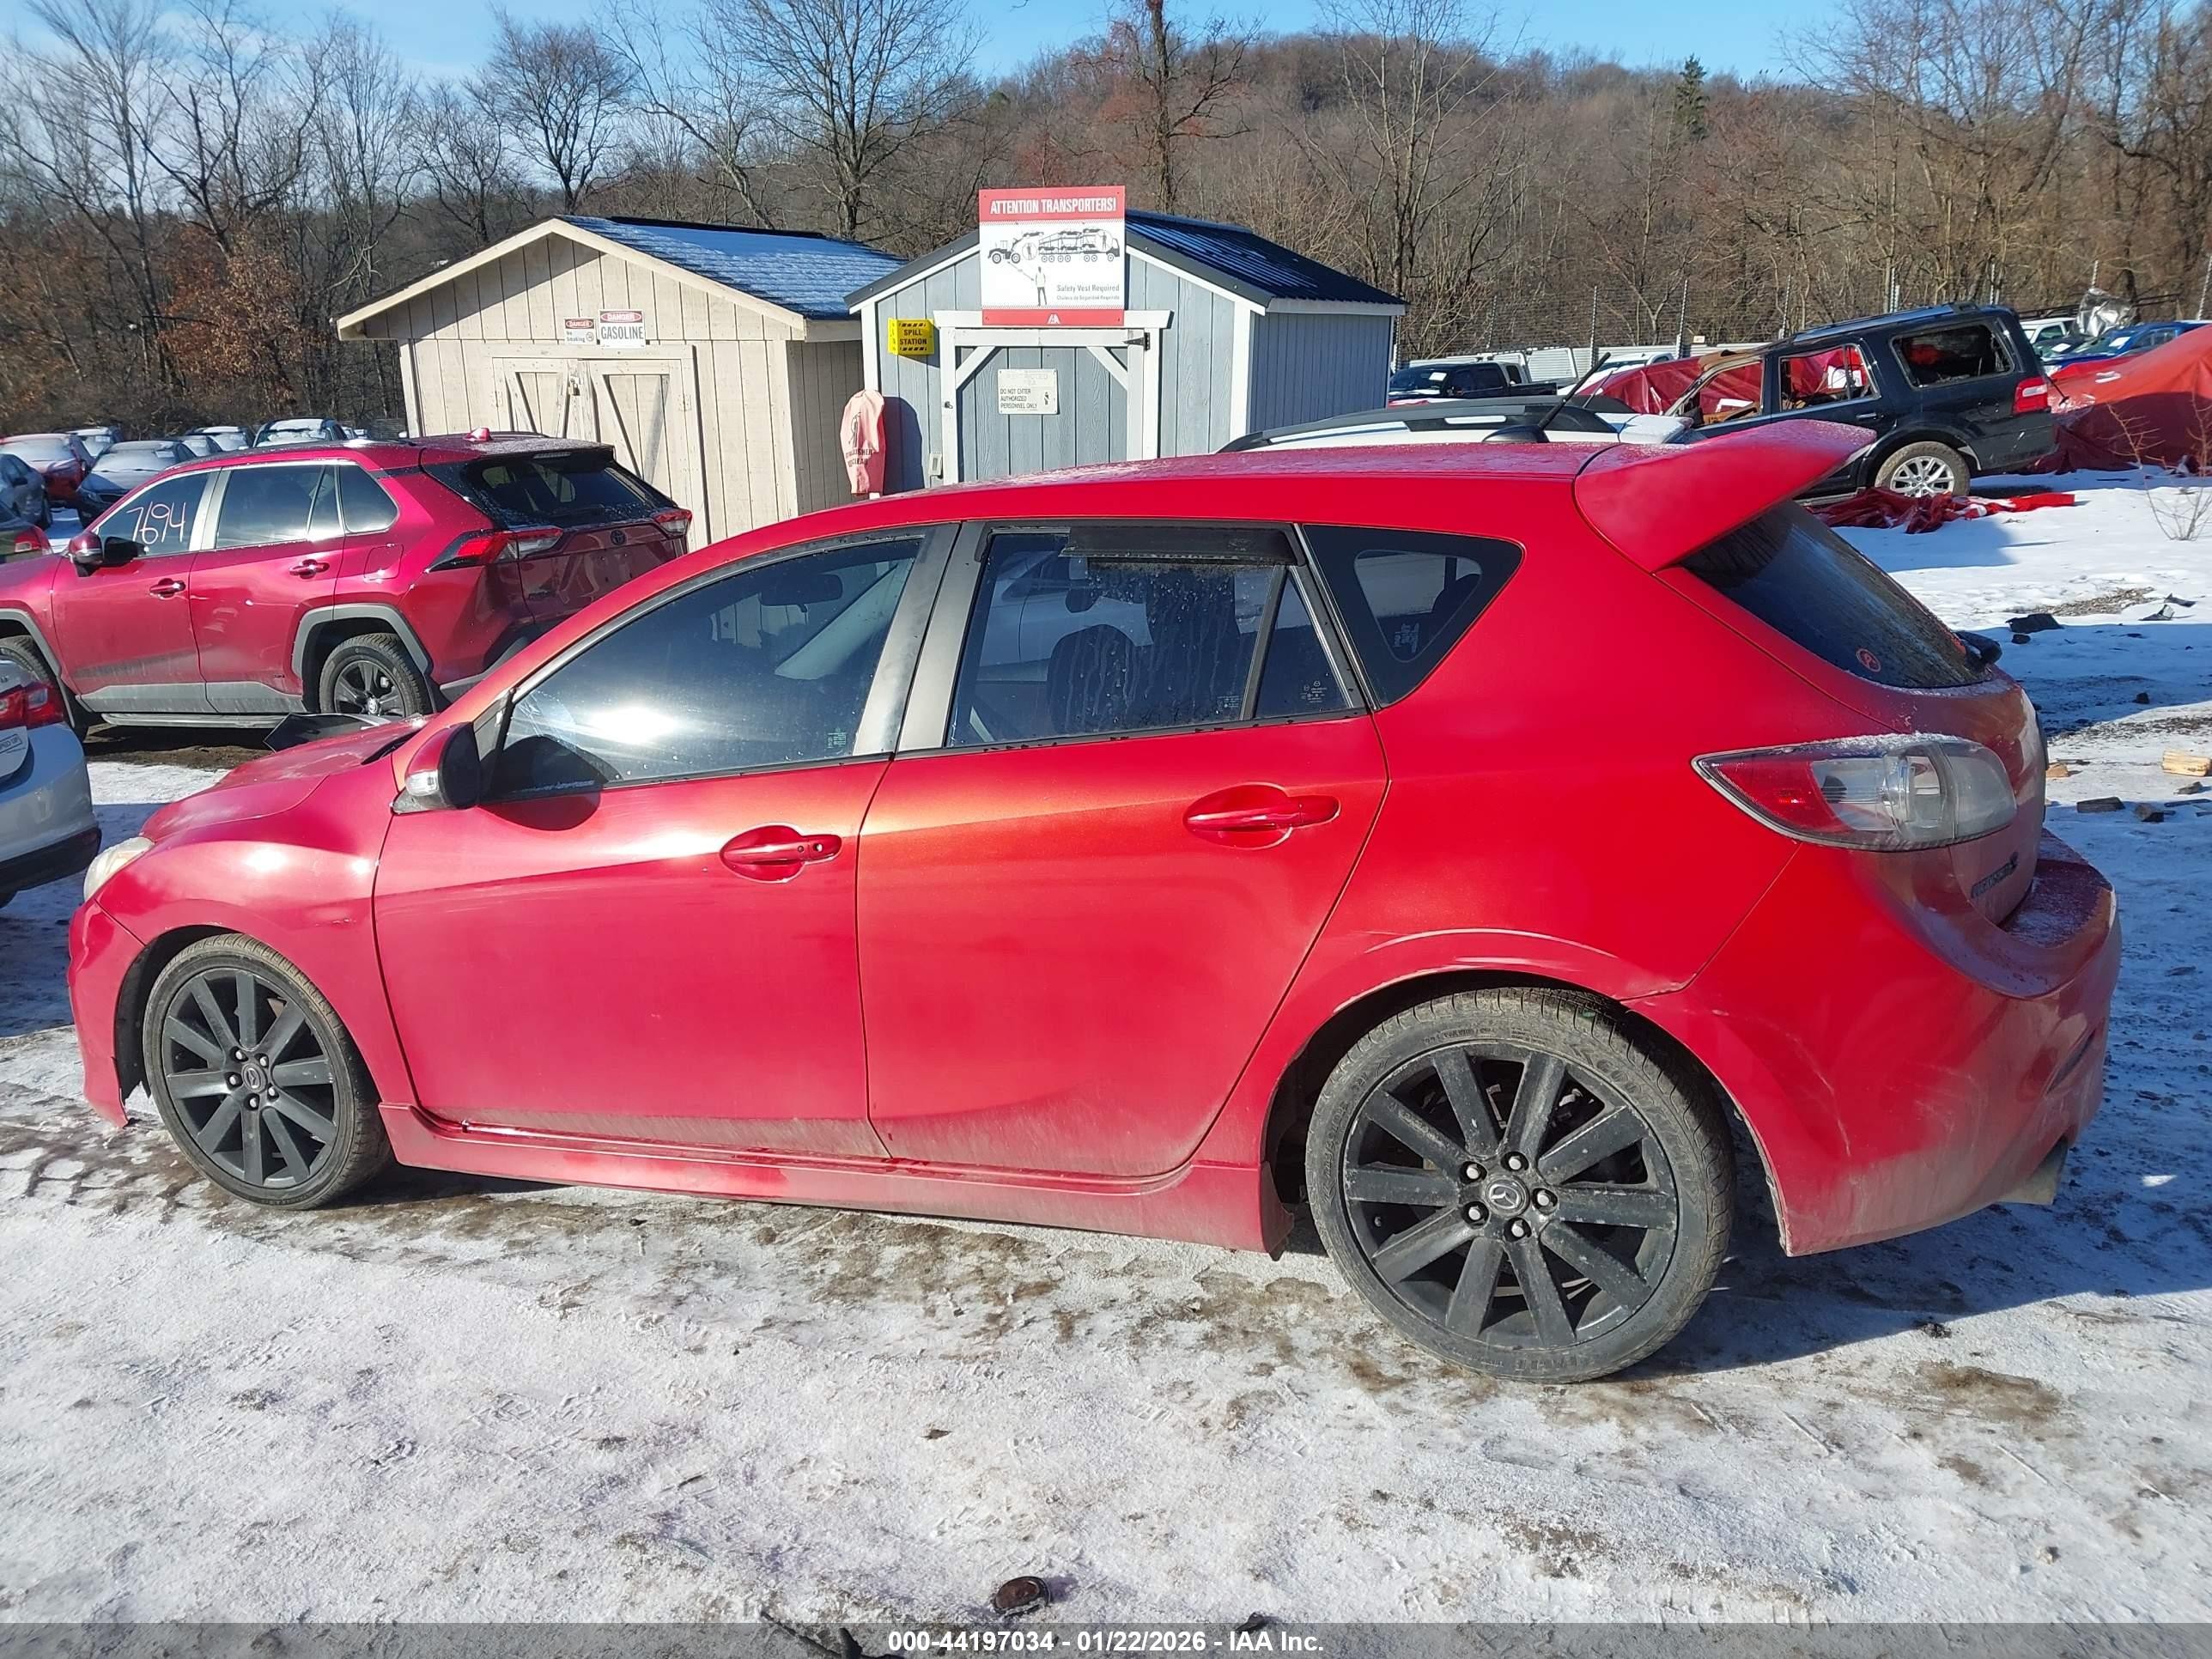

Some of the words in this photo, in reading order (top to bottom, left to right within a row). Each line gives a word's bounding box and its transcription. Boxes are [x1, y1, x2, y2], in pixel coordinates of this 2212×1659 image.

[990, 200, 1039, 214] ATTENTION
[1041, 198, 1116, 213] TRANSPORTERS!
[1057, 284, 1076, 294] Safety
[1091, 283, 1120, 293] Required
[601, 326, 644, 340] GASOLINE
[126, 501, 186, 544] 7694
